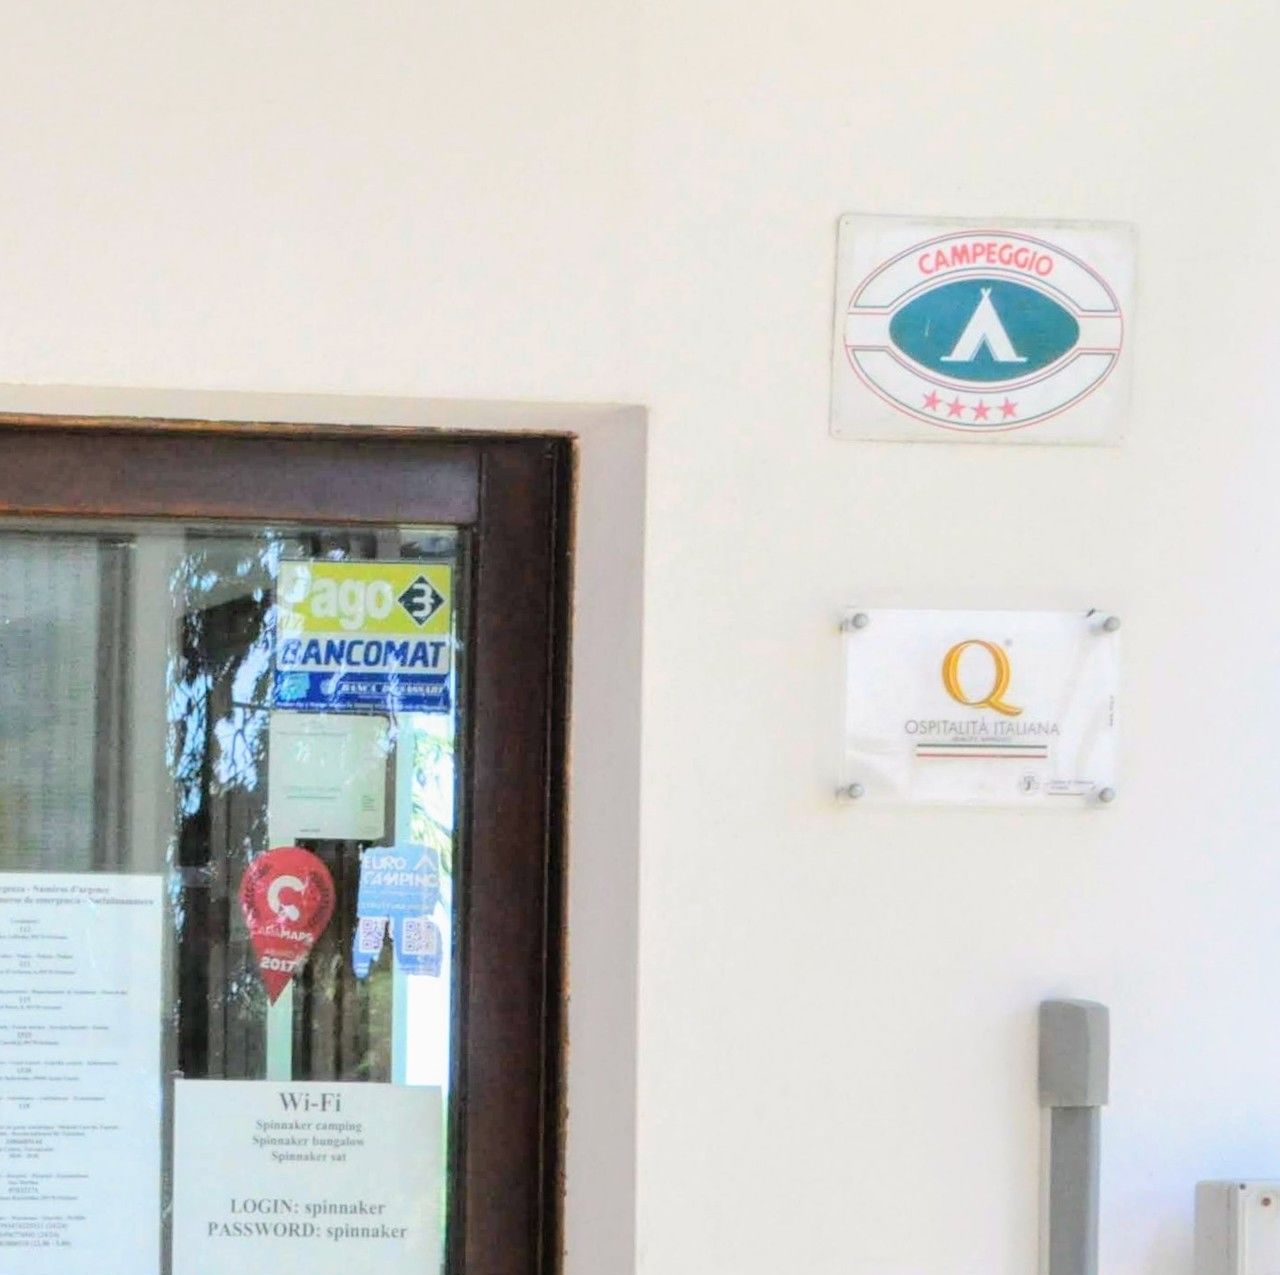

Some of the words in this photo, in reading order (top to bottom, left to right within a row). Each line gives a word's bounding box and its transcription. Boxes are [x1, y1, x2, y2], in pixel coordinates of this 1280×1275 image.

[918, 243, 1054, 277] CAMPEGGIO
[282, 639, 446, 668] BANCOMAT
[942, 640, 1022, 717] Q
[905, 716, 987, 736] OSPITALITÀ
[994, 720, 1060, 737] ITALIANA
[260, 956, 297, 973] 2017
[280, 1092, 342, 1112] Wi-Fi
[256, 1119, 312, 1132] Spinnaker
[316, 1120, 362, 1134] camping
[253, 1135, 308, 1148] Spinnaker
[312, 1135, 365, 1149] bungalow
[272, 1151, 327, 1164] Spinnaker
[231, 1198, 299, 1214] LOGIN:
[305, 1199, 386, 1218] spinnaker
[208, 1221, 321, 1238] PASSWORD:
[327, 1223, 407, 1241] spinnaker
